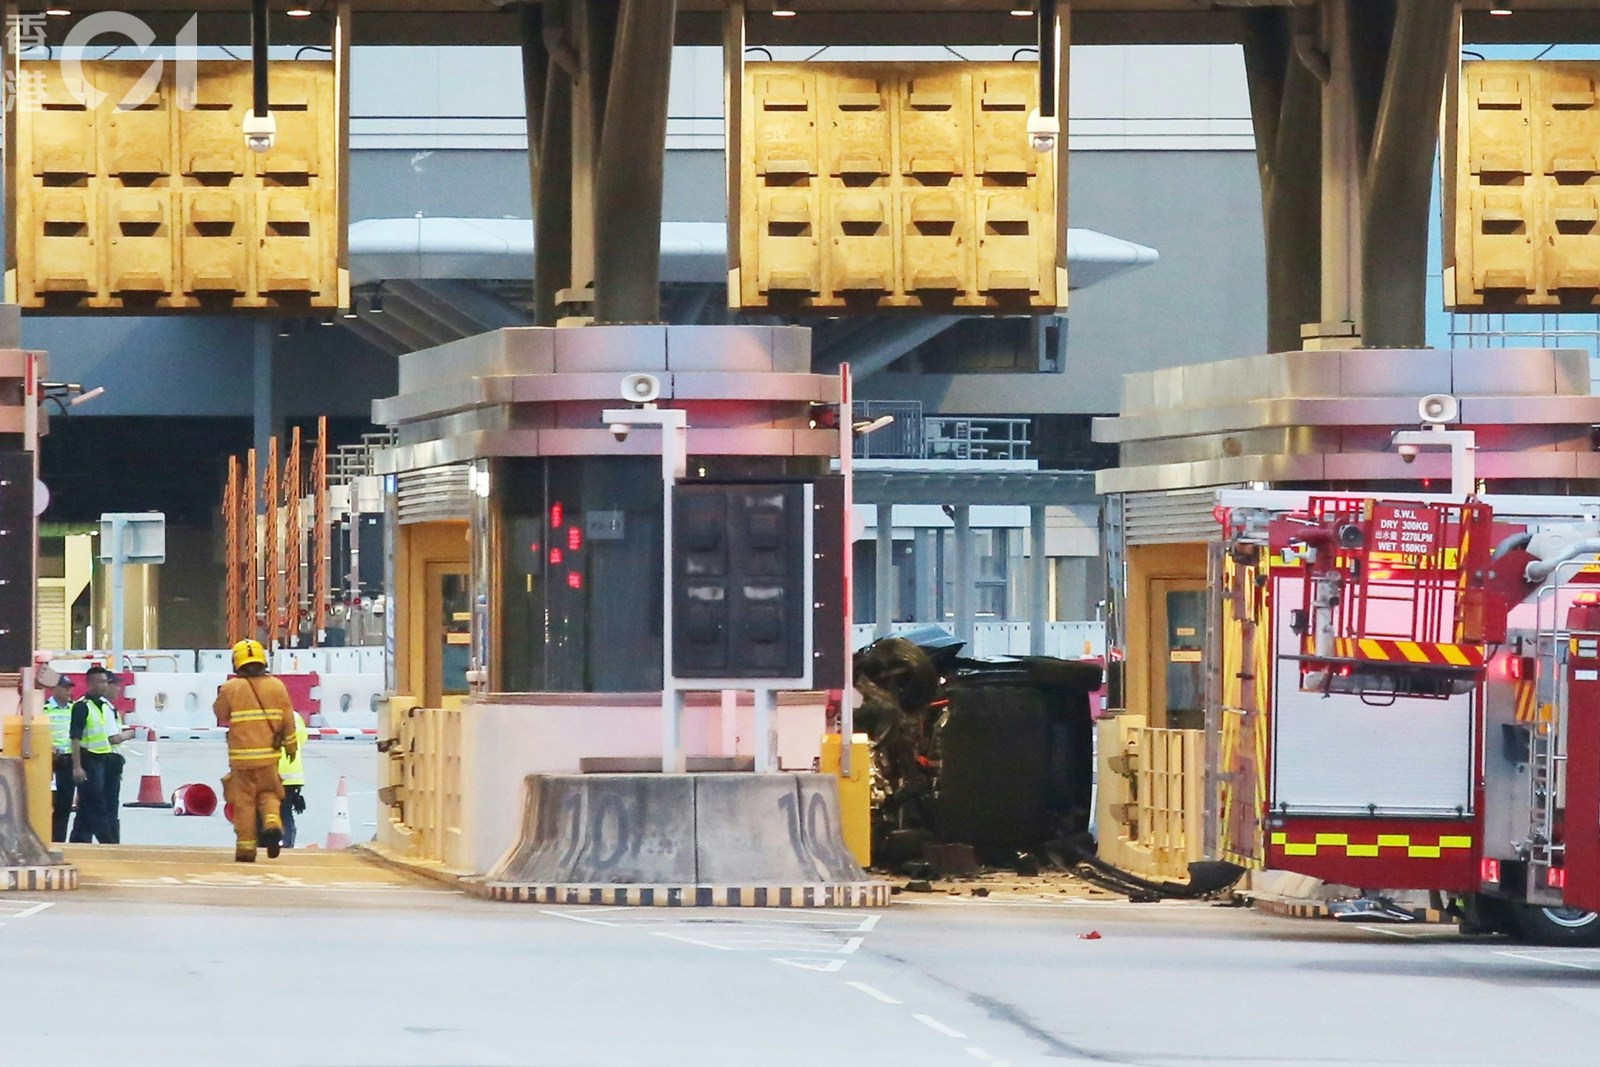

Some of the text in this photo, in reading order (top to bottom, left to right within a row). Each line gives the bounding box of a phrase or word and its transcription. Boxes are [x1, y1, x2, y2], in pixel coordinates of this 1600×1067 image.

[1380, 519, 1429, 531] DRY 300KG
[1375, 531, 1433, 542] 出水量 2270LPM
[1378, 542, 1427, 553] WET 150KG
[557, 791, 629, 868] 10
[776, 791, 845, 866] 10
